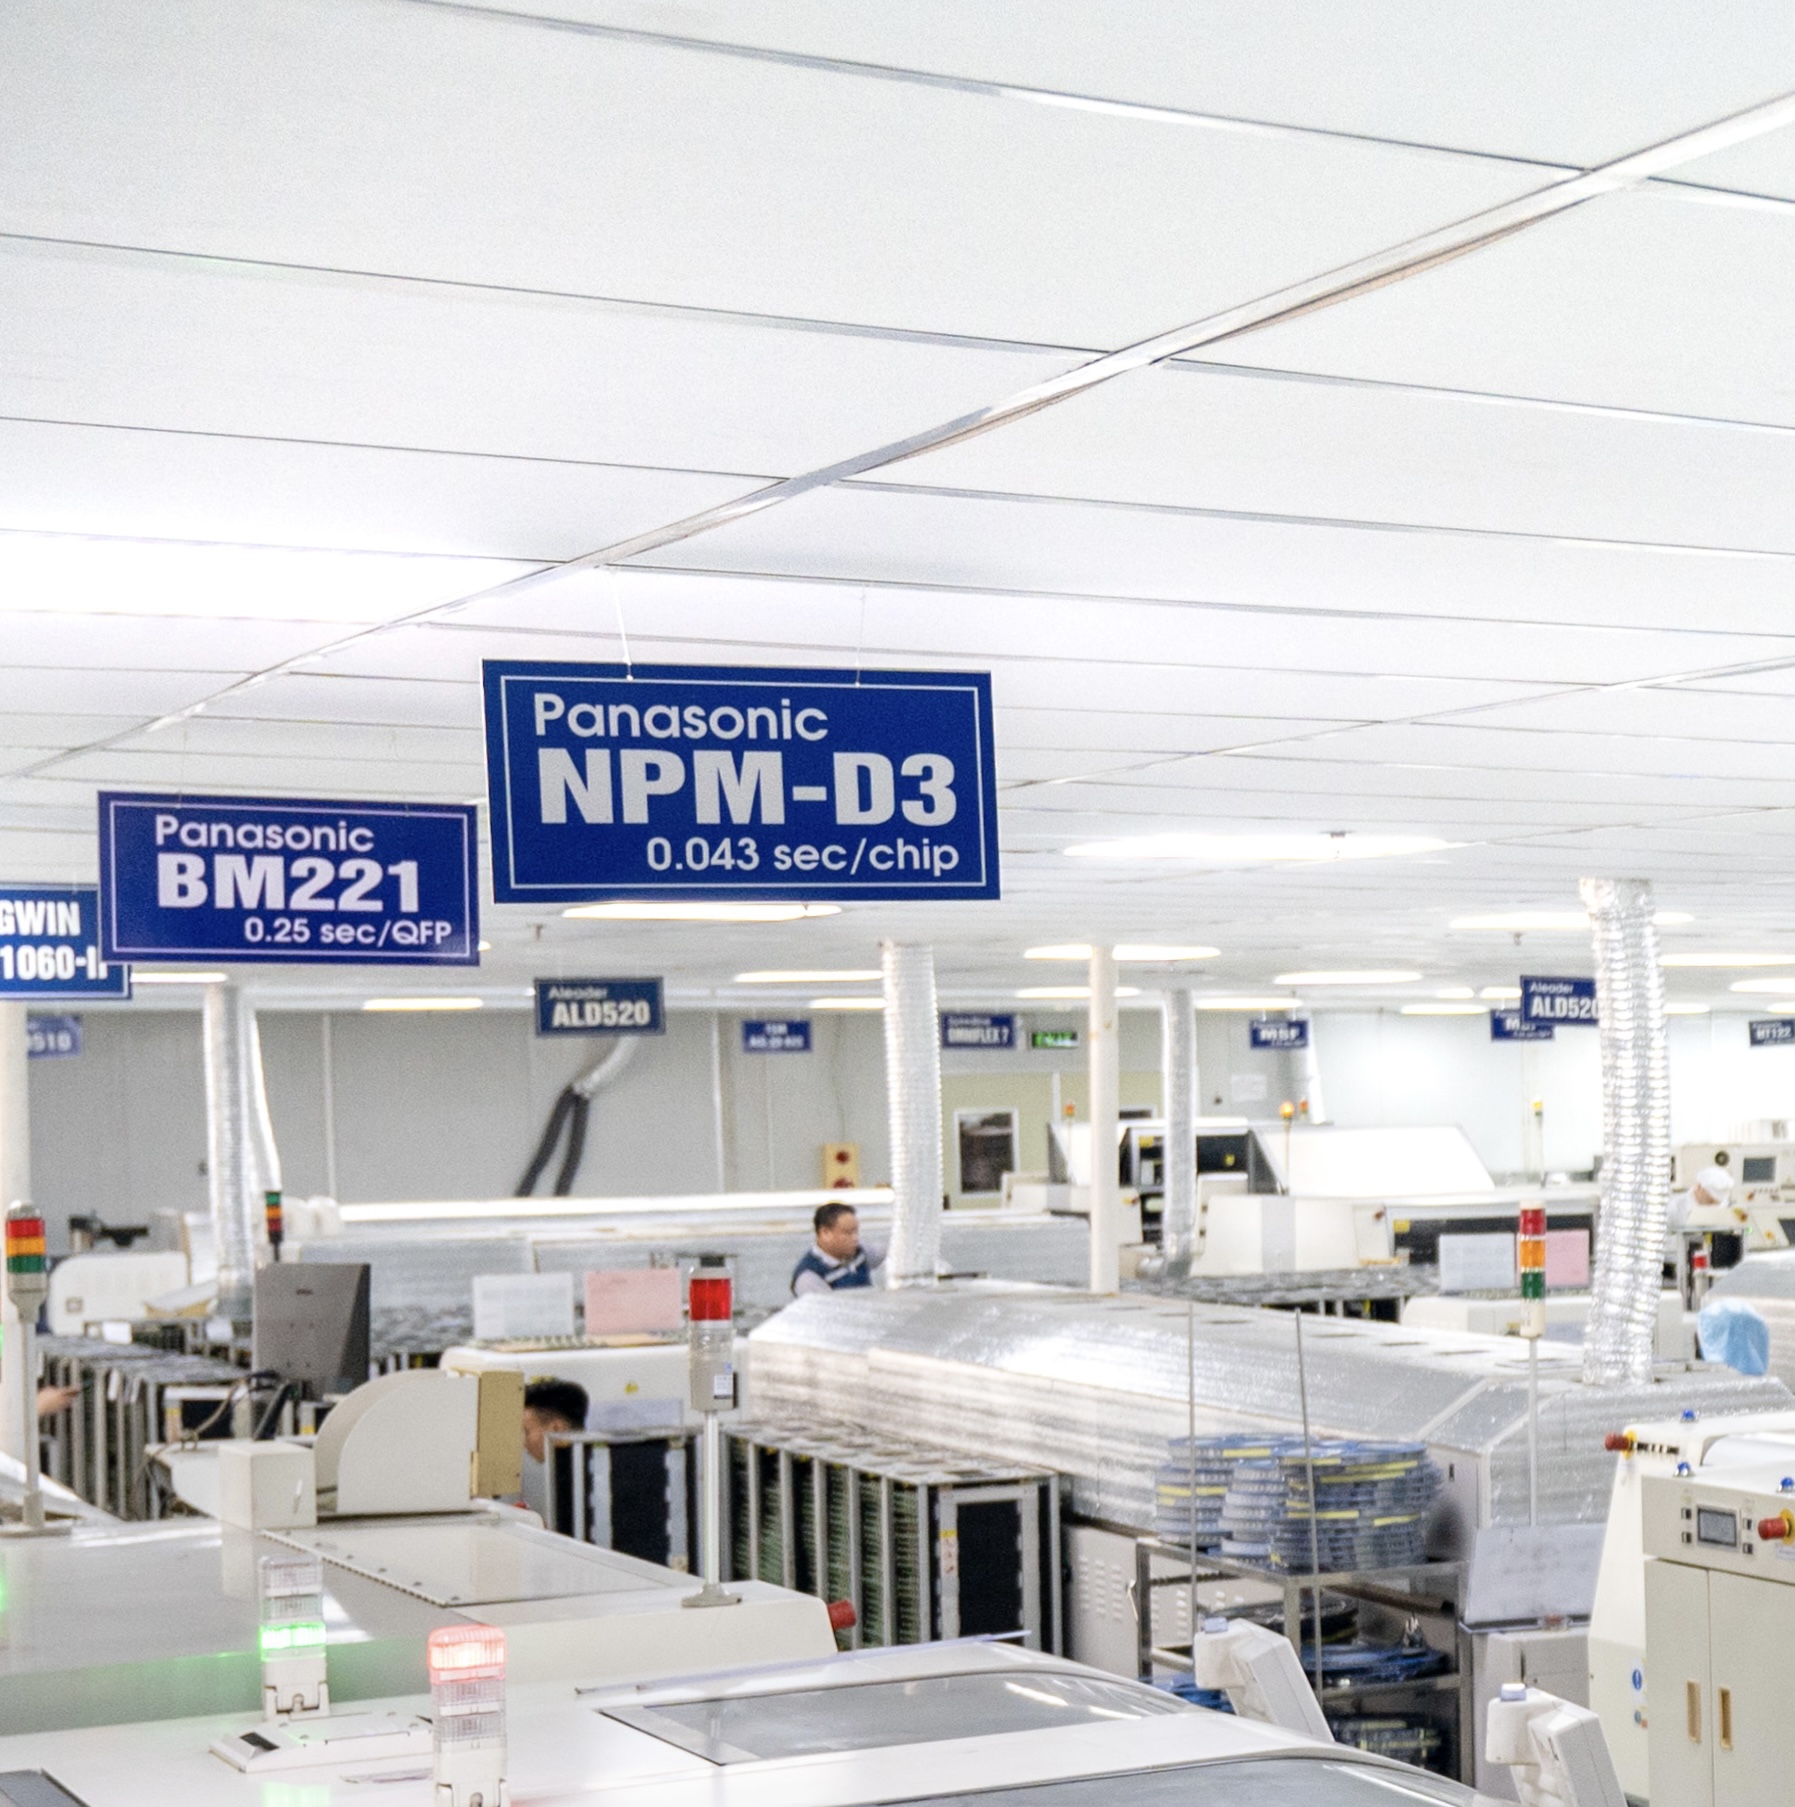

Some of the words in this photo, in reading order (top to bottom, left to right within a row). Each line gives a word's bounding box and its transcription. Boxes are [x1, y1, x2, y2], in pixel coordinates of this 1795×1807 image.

[534, 692, 829, 741] Panasonic
[537, 747, 958, 827] NPM-D3
[155, 814, 375, 852] Panasonic
[646, 836, 761, 871] 0.043
[774, 837, 960, 877] sec/chip
[157, 852, 420, 914] BM221
[243, 917, 311, 943] 0.25
[320, 919, 453, 946] sec/QFP
[552, 1001, 650, 1028] ALD520
[1530, 995, 1600, 1018] ALD520
